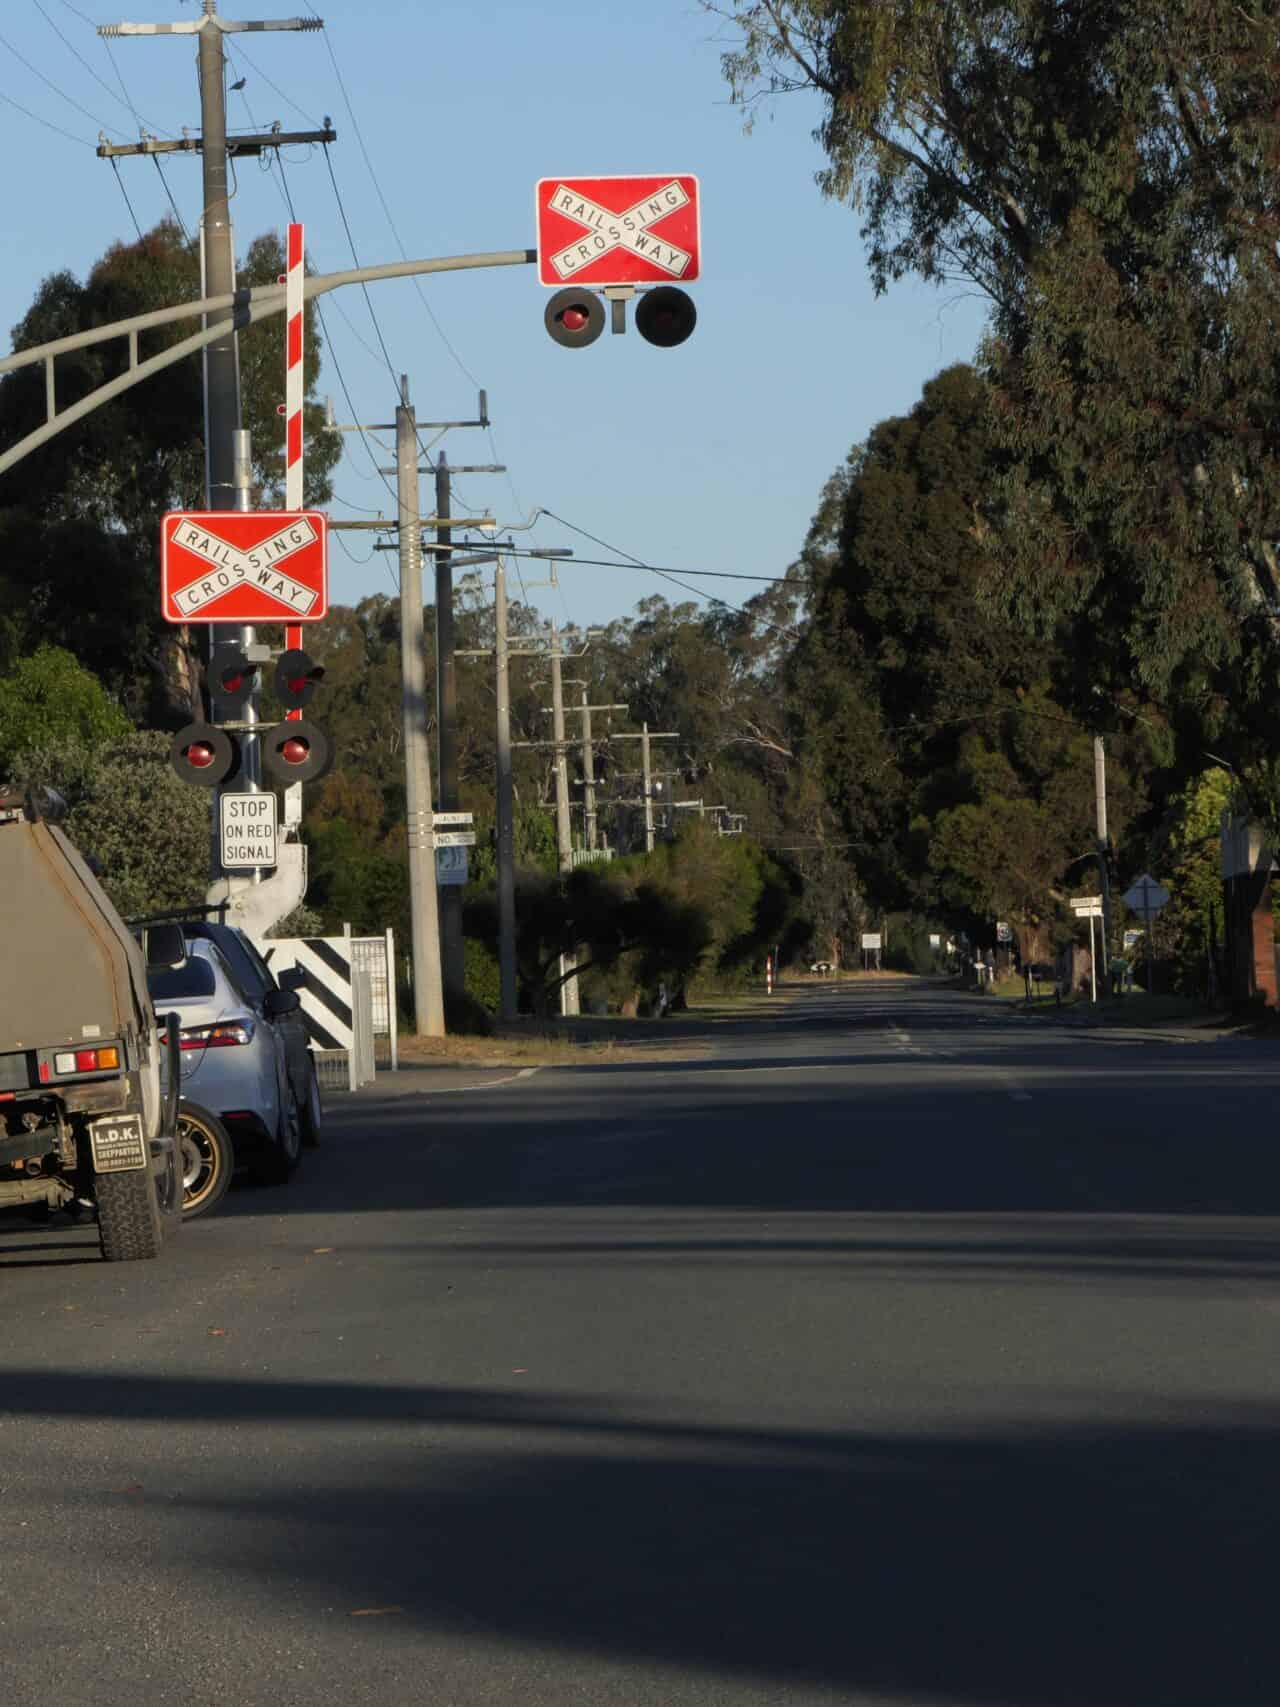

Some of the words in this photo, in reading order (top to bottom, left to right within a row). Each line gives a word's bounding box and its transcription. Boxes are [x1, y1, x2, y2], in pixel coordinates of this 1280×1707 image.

[562, 191, 678, 268] CROSSING
[187, 529, 302, 605] CROSSING
[230, 801, 267, 817] STOP
[226, 825, 243, 838] ON
[247, 824, 272, 838] RED
[227, 845, 272, 859] SIGNAL
[95, 1127, 139, 1144] L.D.K.
